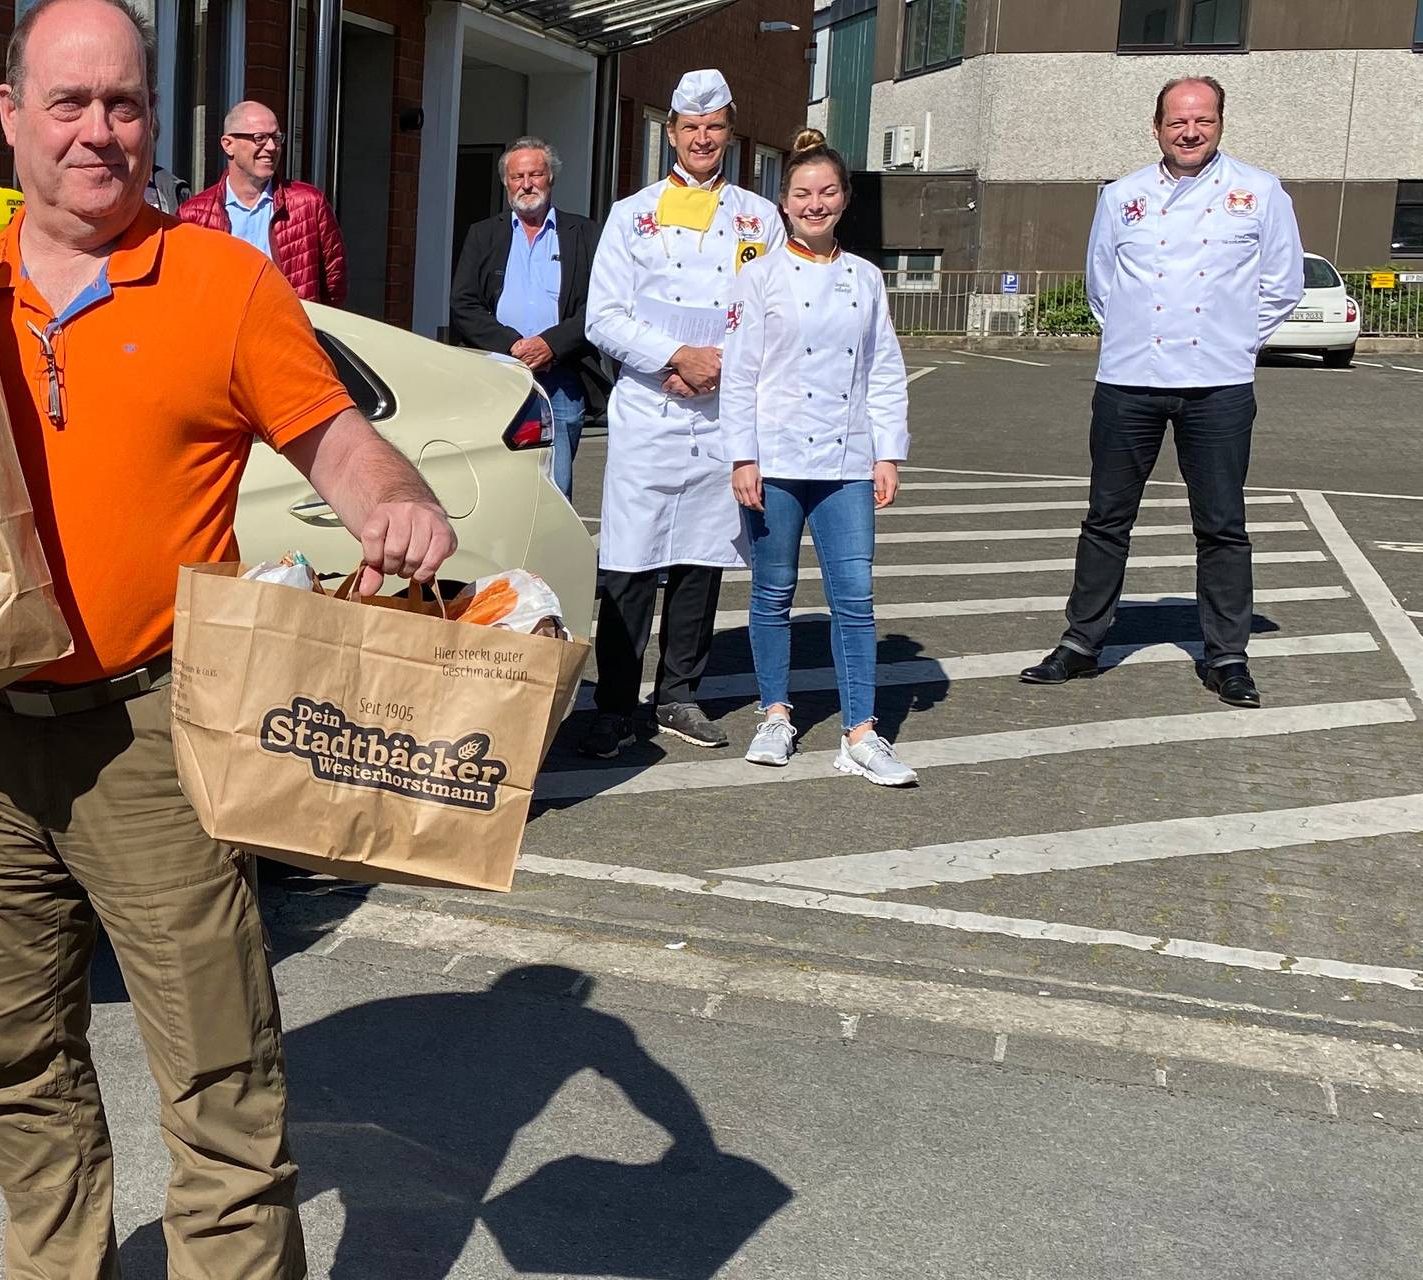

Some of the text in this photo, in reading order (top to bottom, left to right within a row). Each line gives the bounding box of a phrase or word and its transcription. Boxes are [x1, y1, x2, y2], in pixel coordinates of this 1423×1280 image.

[1007, 274, 1015, 285] P
[434, 646, 524, 664] Hier steckt guter
[442, 664, 502, 679] Geschmack
[297, 704, 341, 729] Dein
[359, 697, 414, 722] Seit 1905
[267, 715, 501, 787] Stadtbäcker
[317, 755, 490, 804] Westerhorstmann
